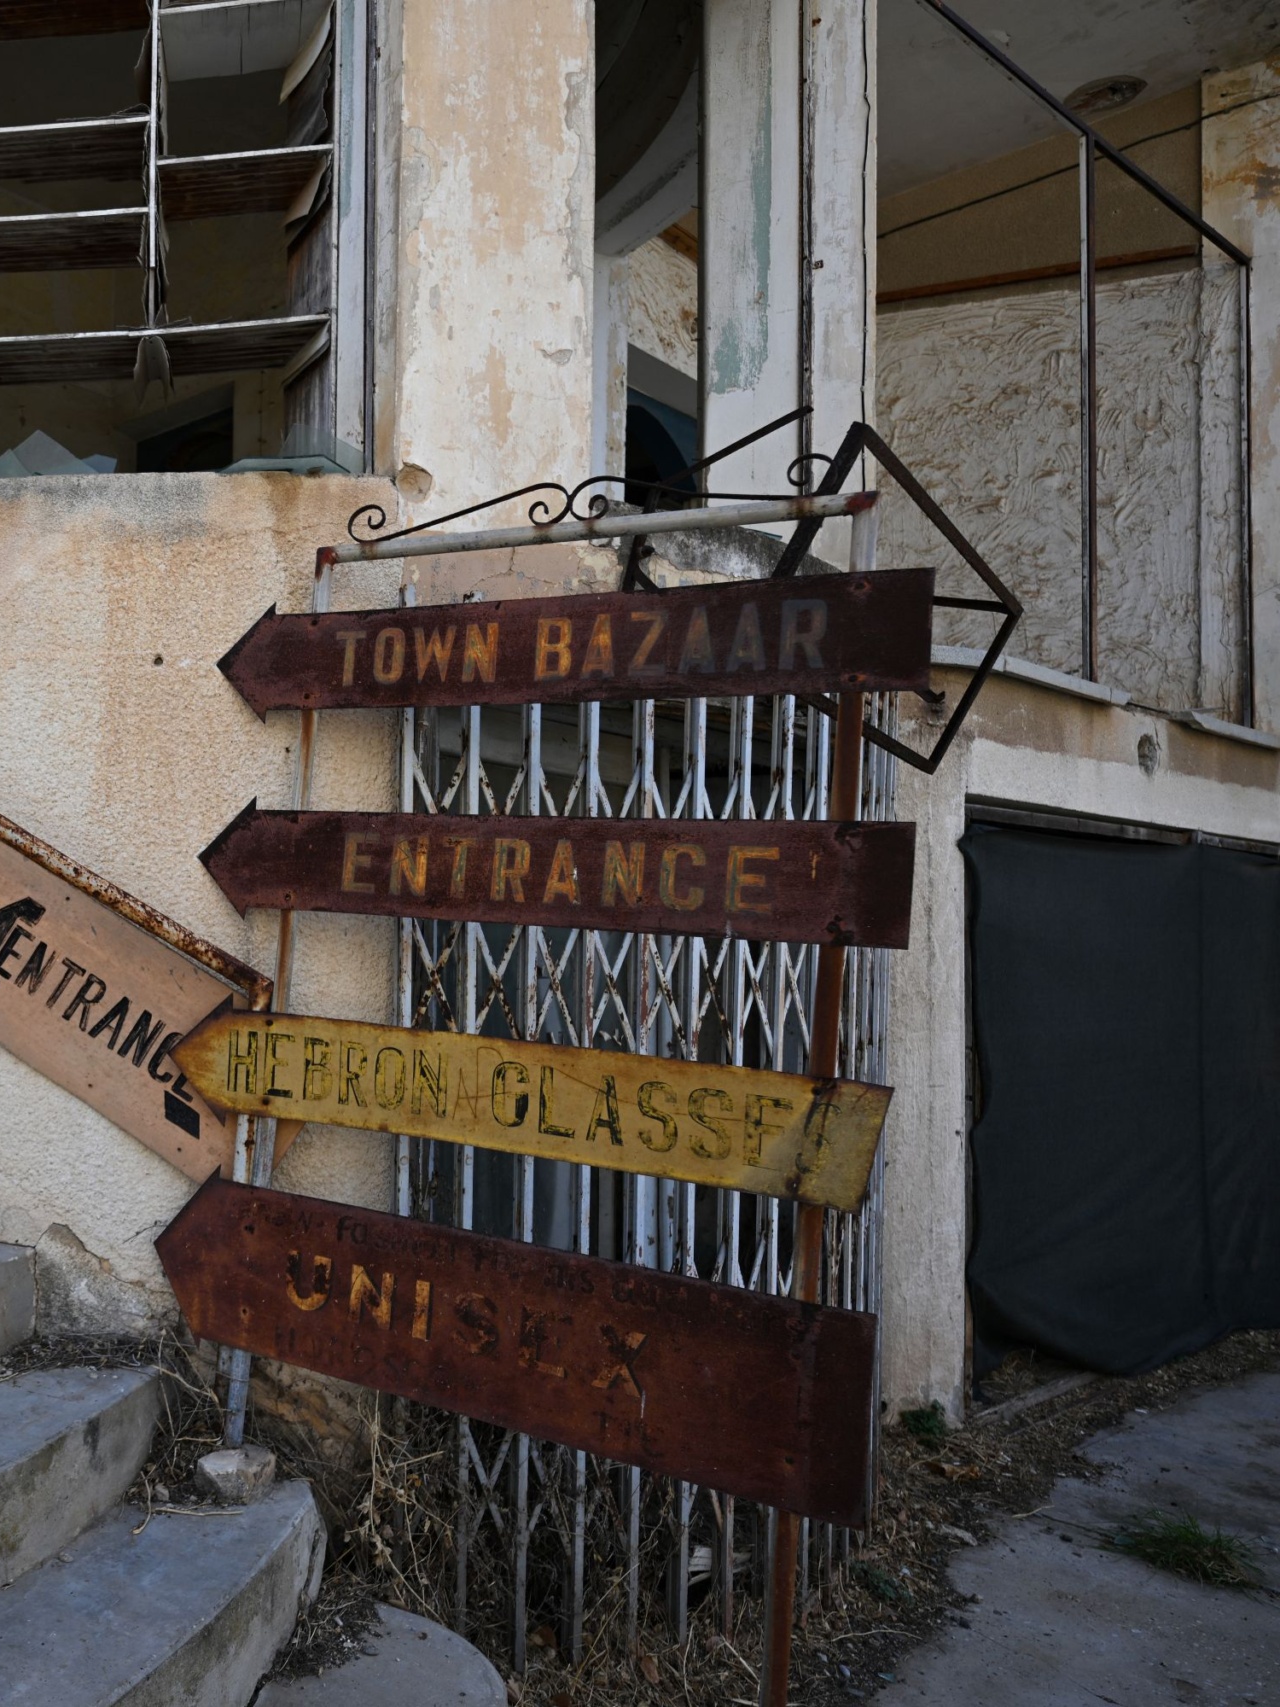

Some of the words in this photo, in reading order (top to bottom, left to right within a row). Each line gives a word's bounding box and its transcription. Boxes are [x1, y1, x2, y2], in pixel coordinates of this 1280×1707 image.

[335, 621, 500, 688] TOWN
[532, 597, 829, 684] BAZAAR
[340, 831, 781, 915] ENTRANCE
[226, 1029, 448, 1119] HEBRON
[284, 1248, 649, 1399] UNISEX
